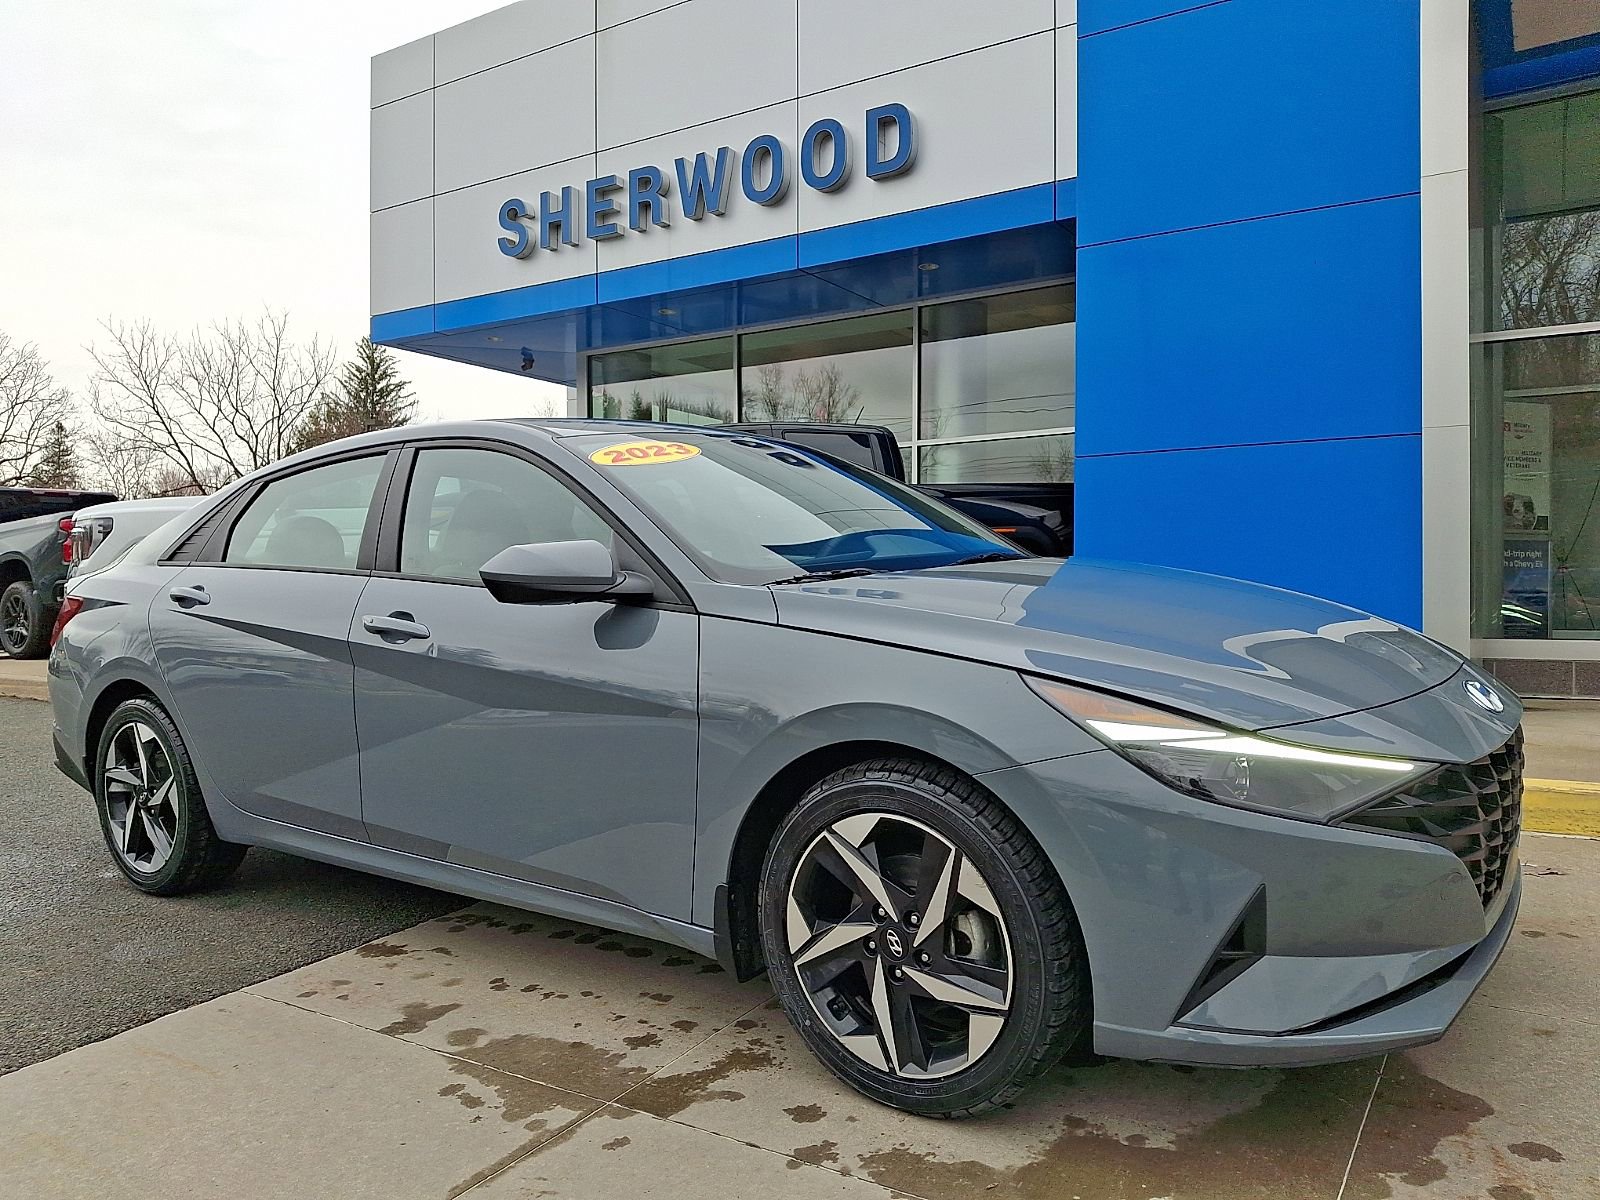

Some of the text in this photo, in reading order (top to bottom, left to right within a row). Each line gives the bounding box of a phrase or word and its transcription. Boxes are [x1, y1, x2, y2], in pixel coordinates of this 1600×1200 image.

[498, 102, 919, 260] SHERWOOD
[603, 443, 693, 463] 2023
[1504, 550, 1542, 559] ad-trip right
[1514, 559, 1533, 569] Chevy
